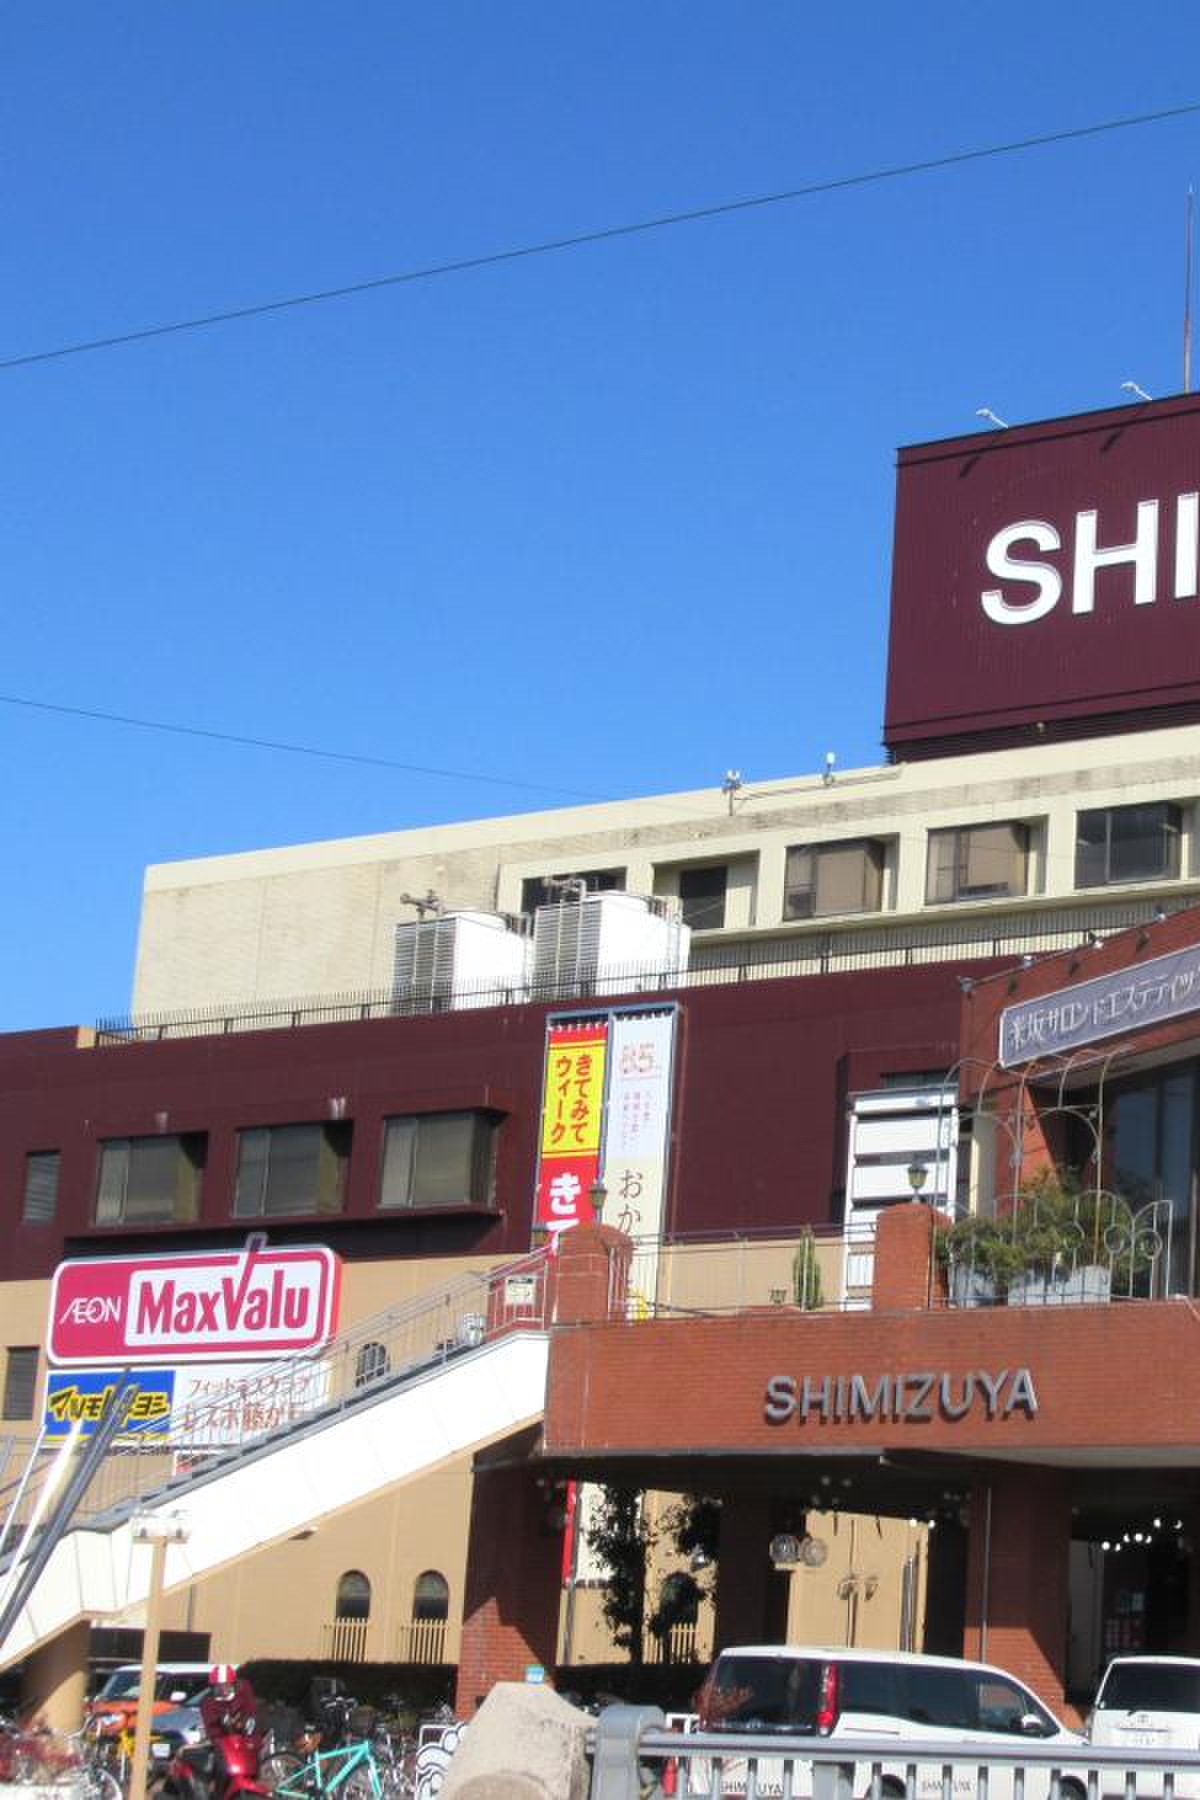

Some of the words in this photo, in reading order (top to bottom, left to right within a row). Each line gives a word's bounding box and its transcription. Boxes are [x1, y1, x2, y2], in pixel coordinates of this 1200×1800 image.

[551, 1056, 573, 1145] ウィーク
[571, 1054, 593, 1143] きてみて
[136, 1240, 310, 1335] MaxValu
[766, 1368, 1039, 1424] SHIMIZUYA
[720, 1779, 785, 1796] SHIMUYA
